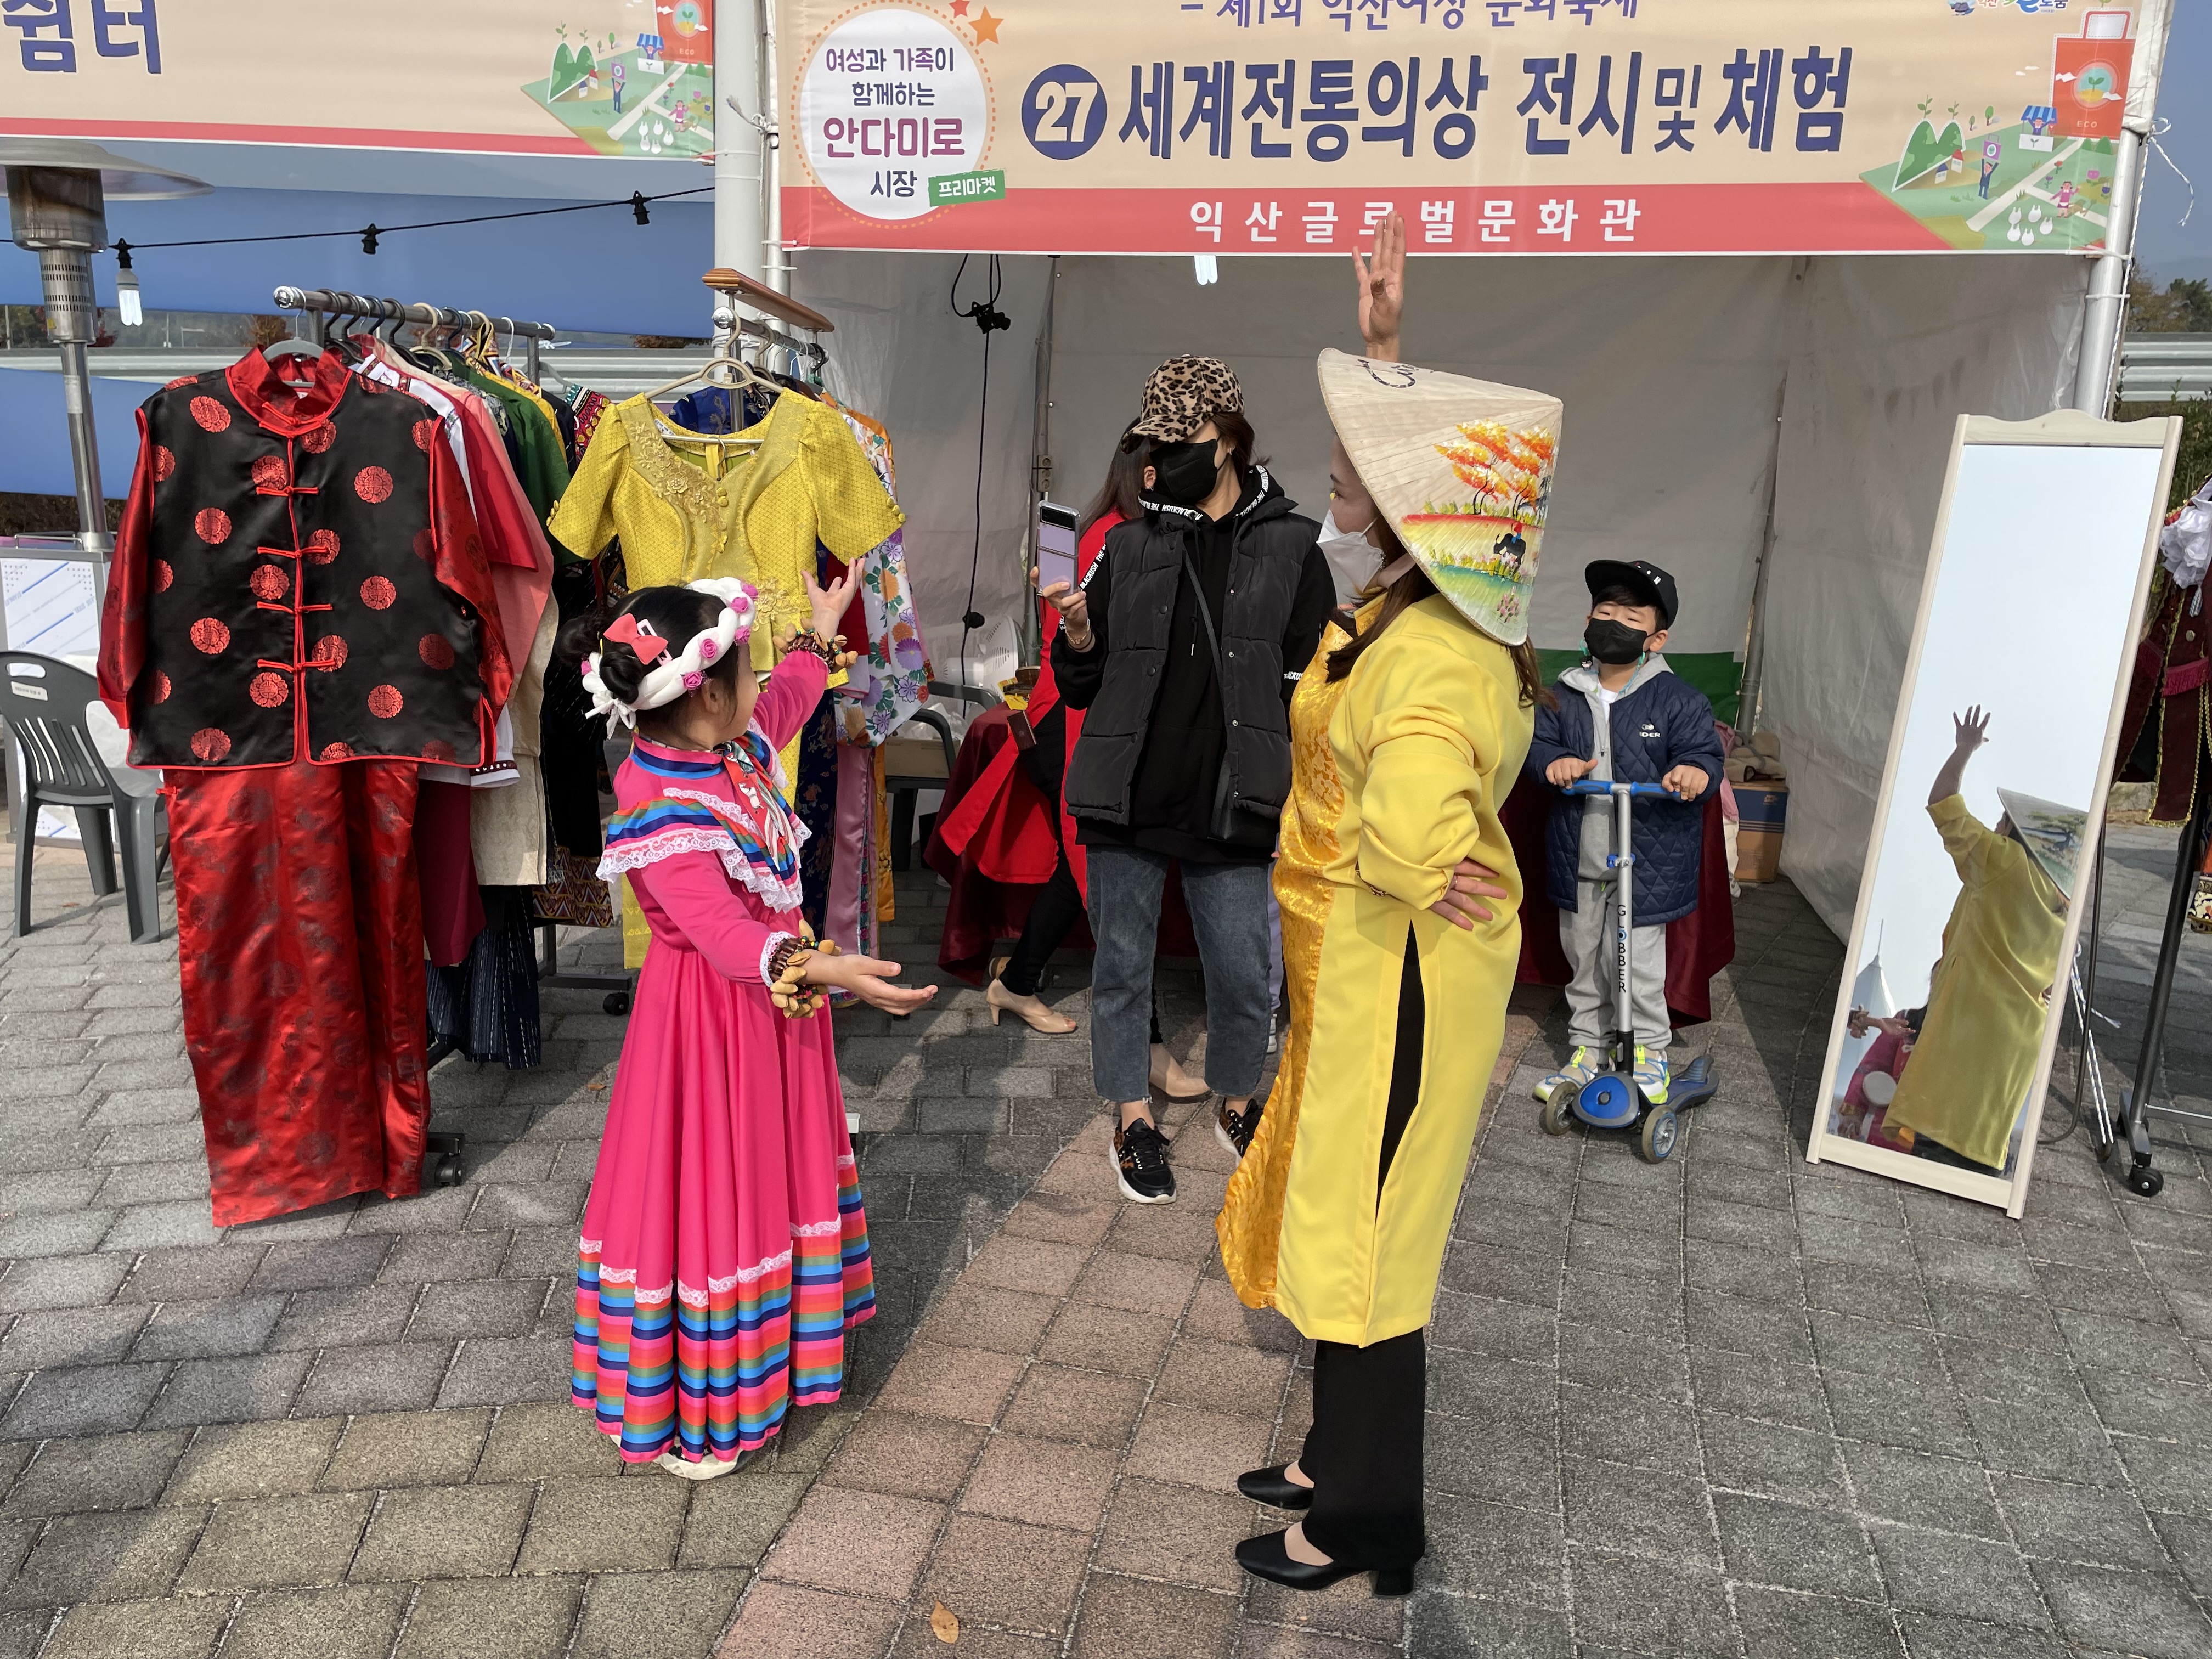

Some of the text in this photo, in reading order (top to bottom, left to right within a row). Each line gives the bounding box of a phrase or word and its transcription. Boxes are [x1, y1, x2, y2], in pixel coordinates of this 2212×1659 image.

[826, 47, 954, 72] 여성과 가족이
[851, 82, 935, 106] 함께하는
[1035, 81, 1098, 143] 27
[1118, 56, 1489, 162] 세계전통의상
[1714, 46, 1853, 153] 체험
[823, 117, 966, 159] 안다미로
[2076, 120, 2097, 128] ECO
[870, 170, 918, 198] 시장
[938, 176, 996, 198] 프리마켓
[1079, 550, 1105, 590] BLACKUSH THE
[1617, 904, 1627, 994] GLOBBER
